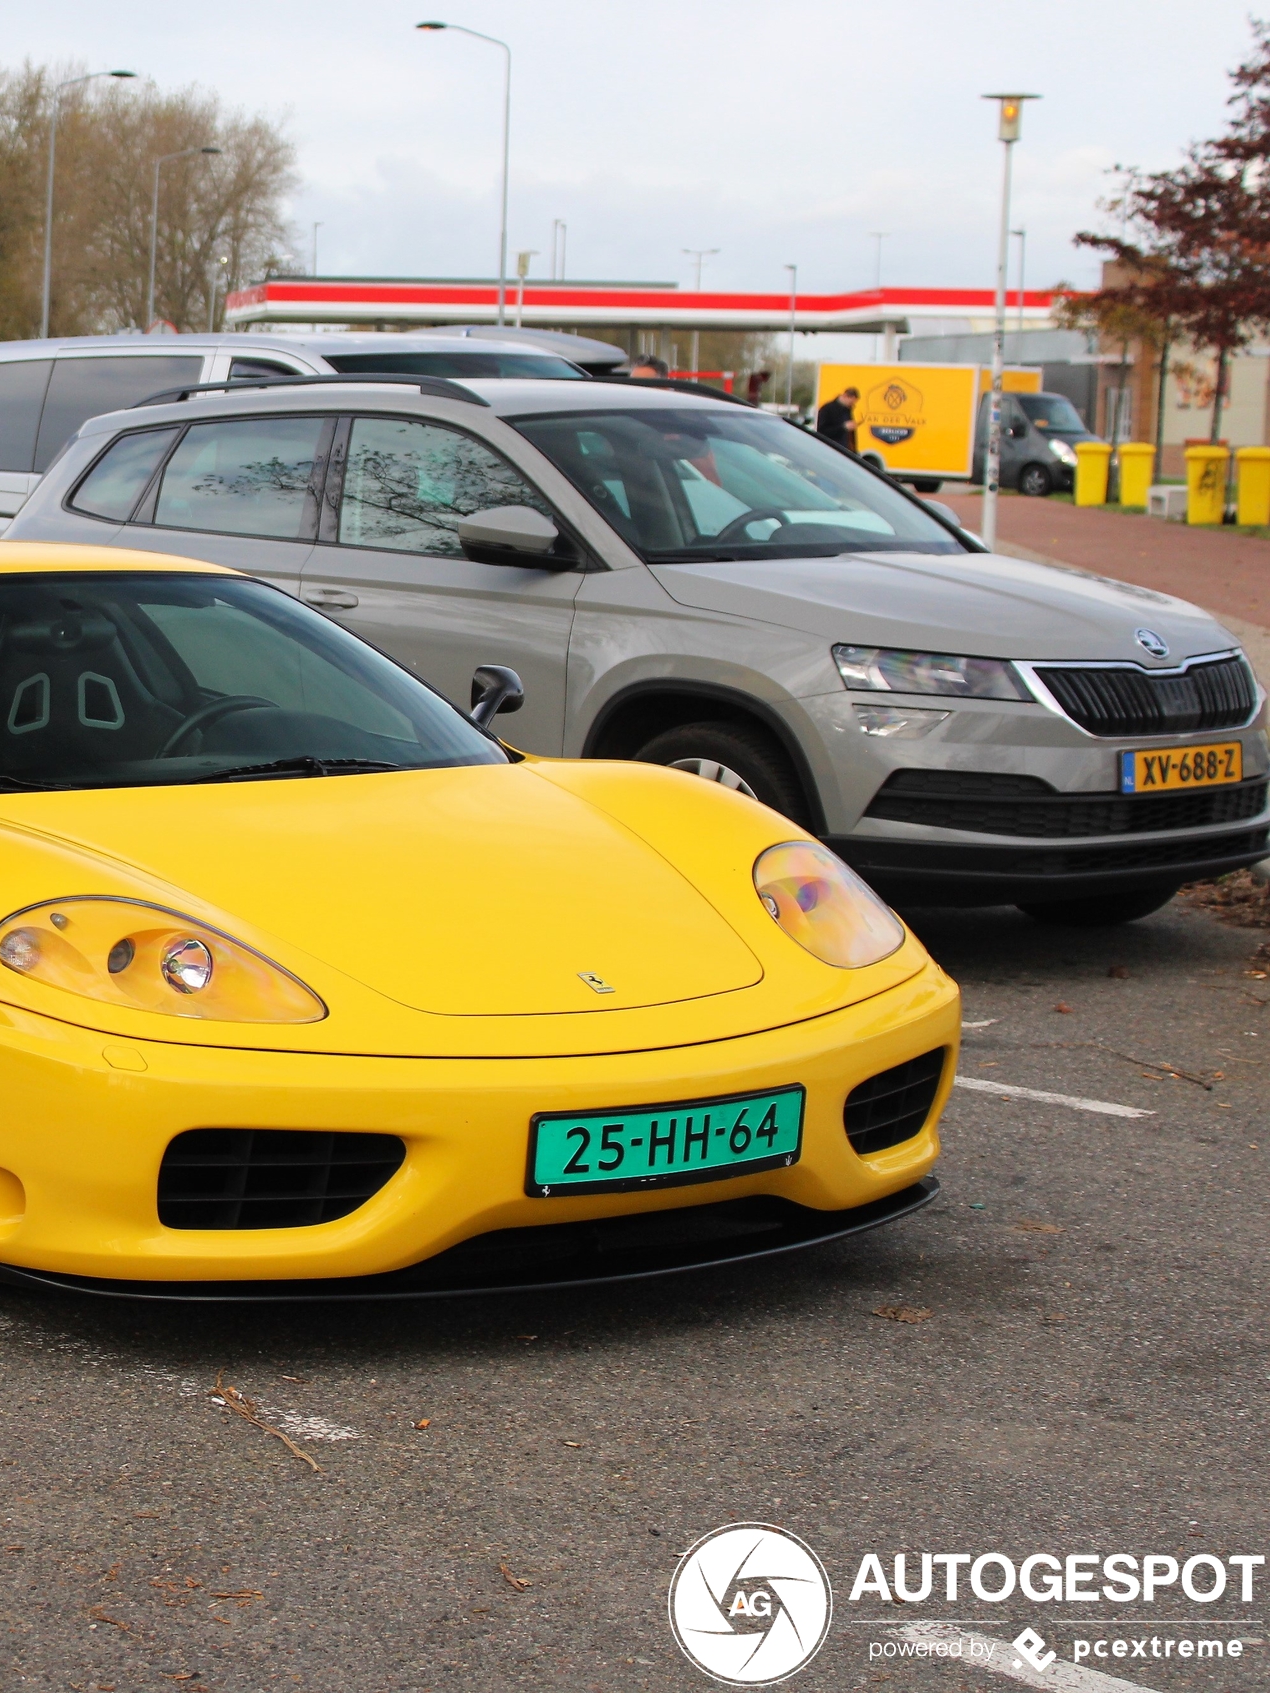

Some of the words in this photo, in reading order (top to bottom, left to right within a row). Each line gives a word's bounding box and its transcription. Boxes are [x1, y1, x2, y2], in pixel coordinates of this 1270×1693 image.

[1124, 776, 1134, 786] NL
[1143, 748, 1236, 786] XV-688-Z
[562, 1101, 780, 1175] 25-HH-64
